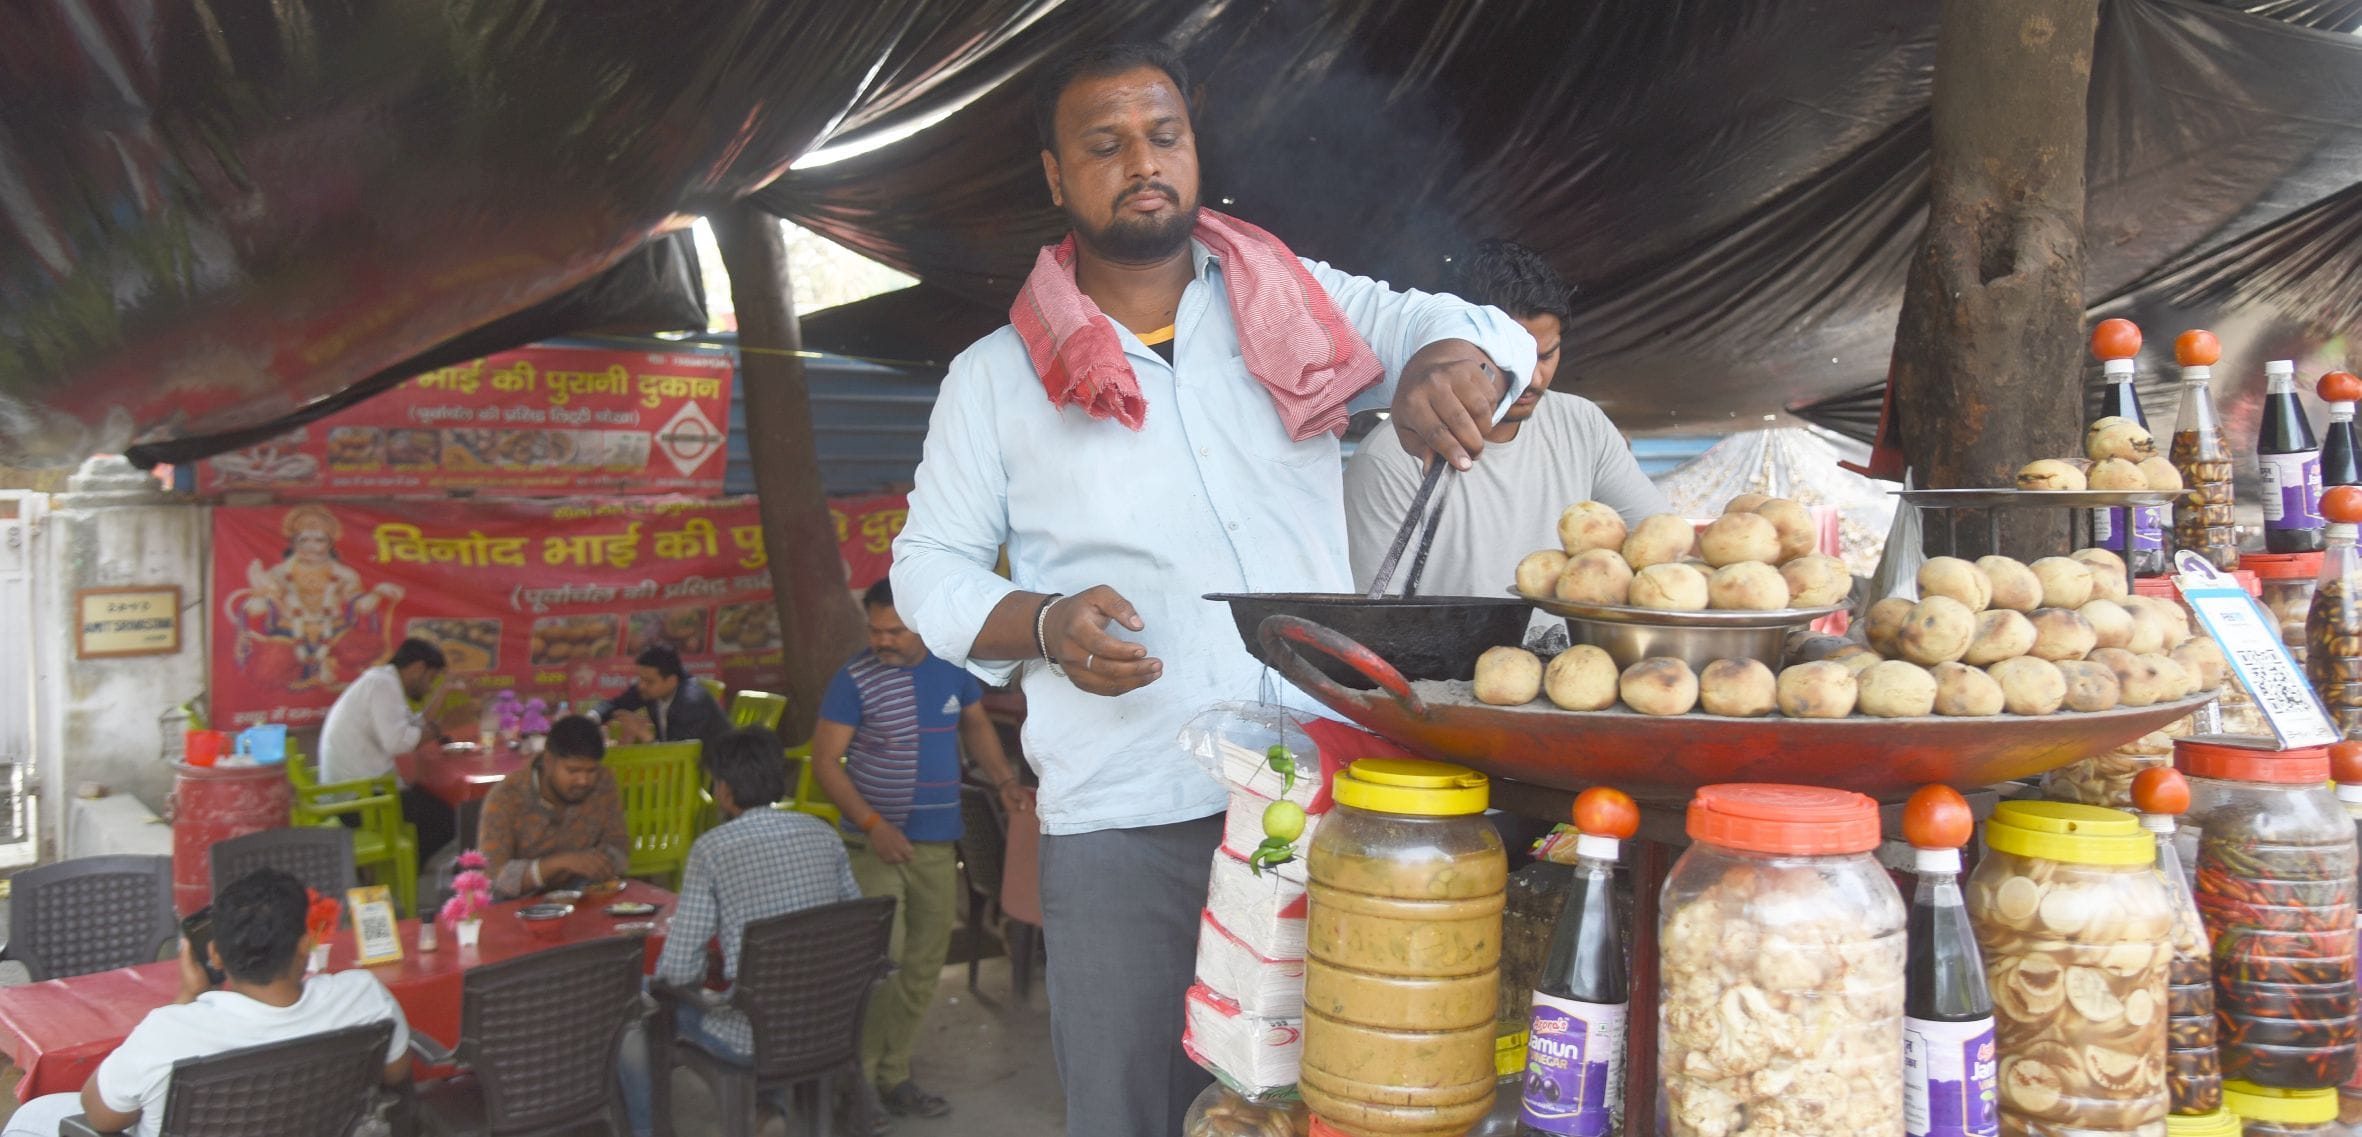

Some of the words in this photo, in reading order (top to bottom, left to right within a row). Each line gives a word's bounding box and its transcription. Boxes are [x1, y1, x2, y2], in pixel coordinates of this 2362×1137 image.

[490, 361, 536, 392] की
[546, 364, 629, 405] पुरानी
[637, 374, 721, 408] दुकान
[373, 523, 529, 567] विनोद
[543, 521, 643, 569] भाई
[654, 517, 719, 561] की
